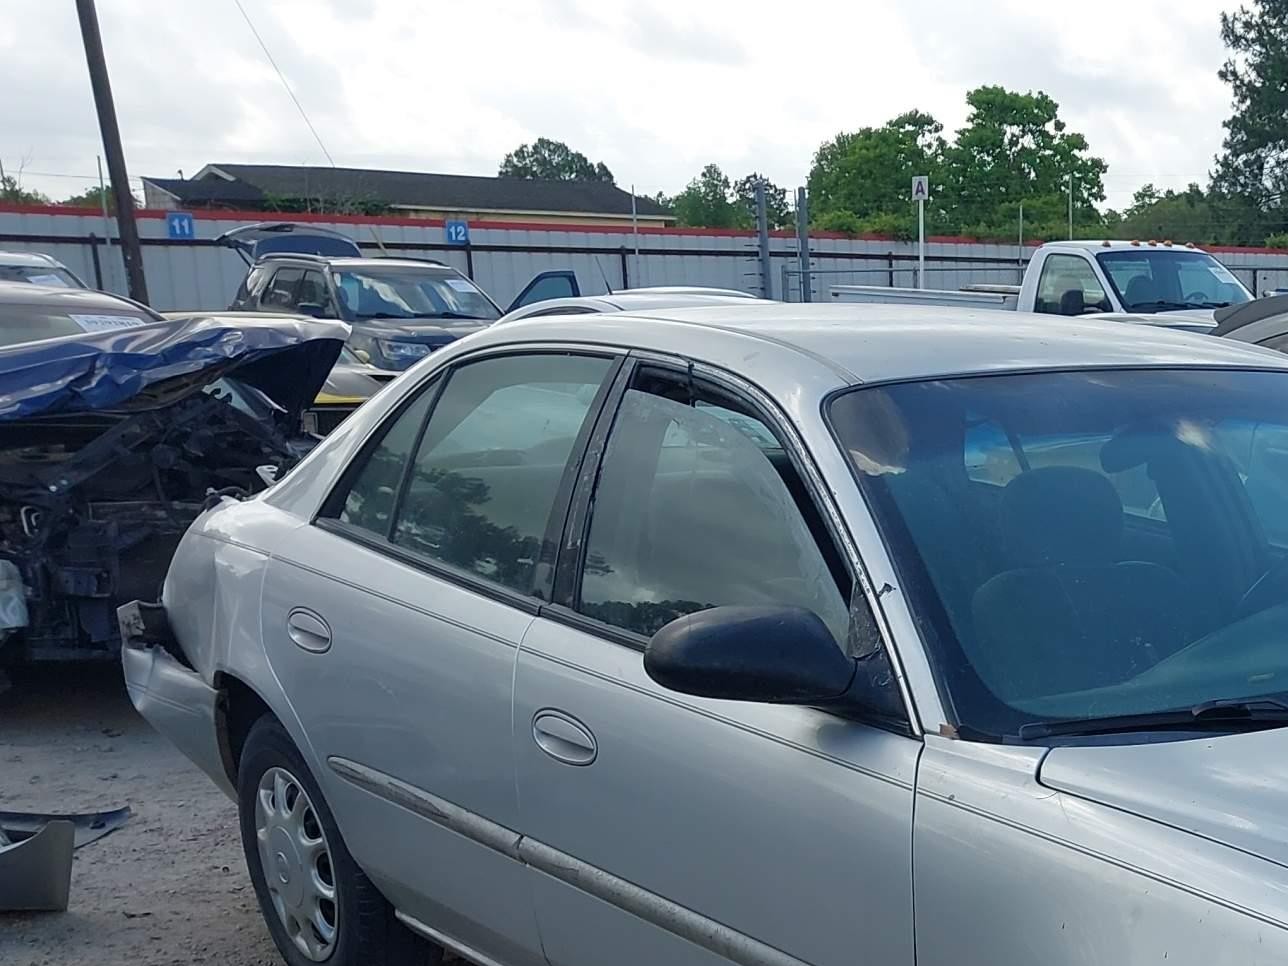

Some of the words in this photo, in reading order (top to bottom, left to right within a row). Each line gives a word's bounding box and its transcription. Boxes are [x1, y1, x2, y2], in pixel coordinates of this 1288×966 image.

[915, 180, 926, 195] A
[172, 217, 190, 235] 11
[449, 225, 466, 241] 12
